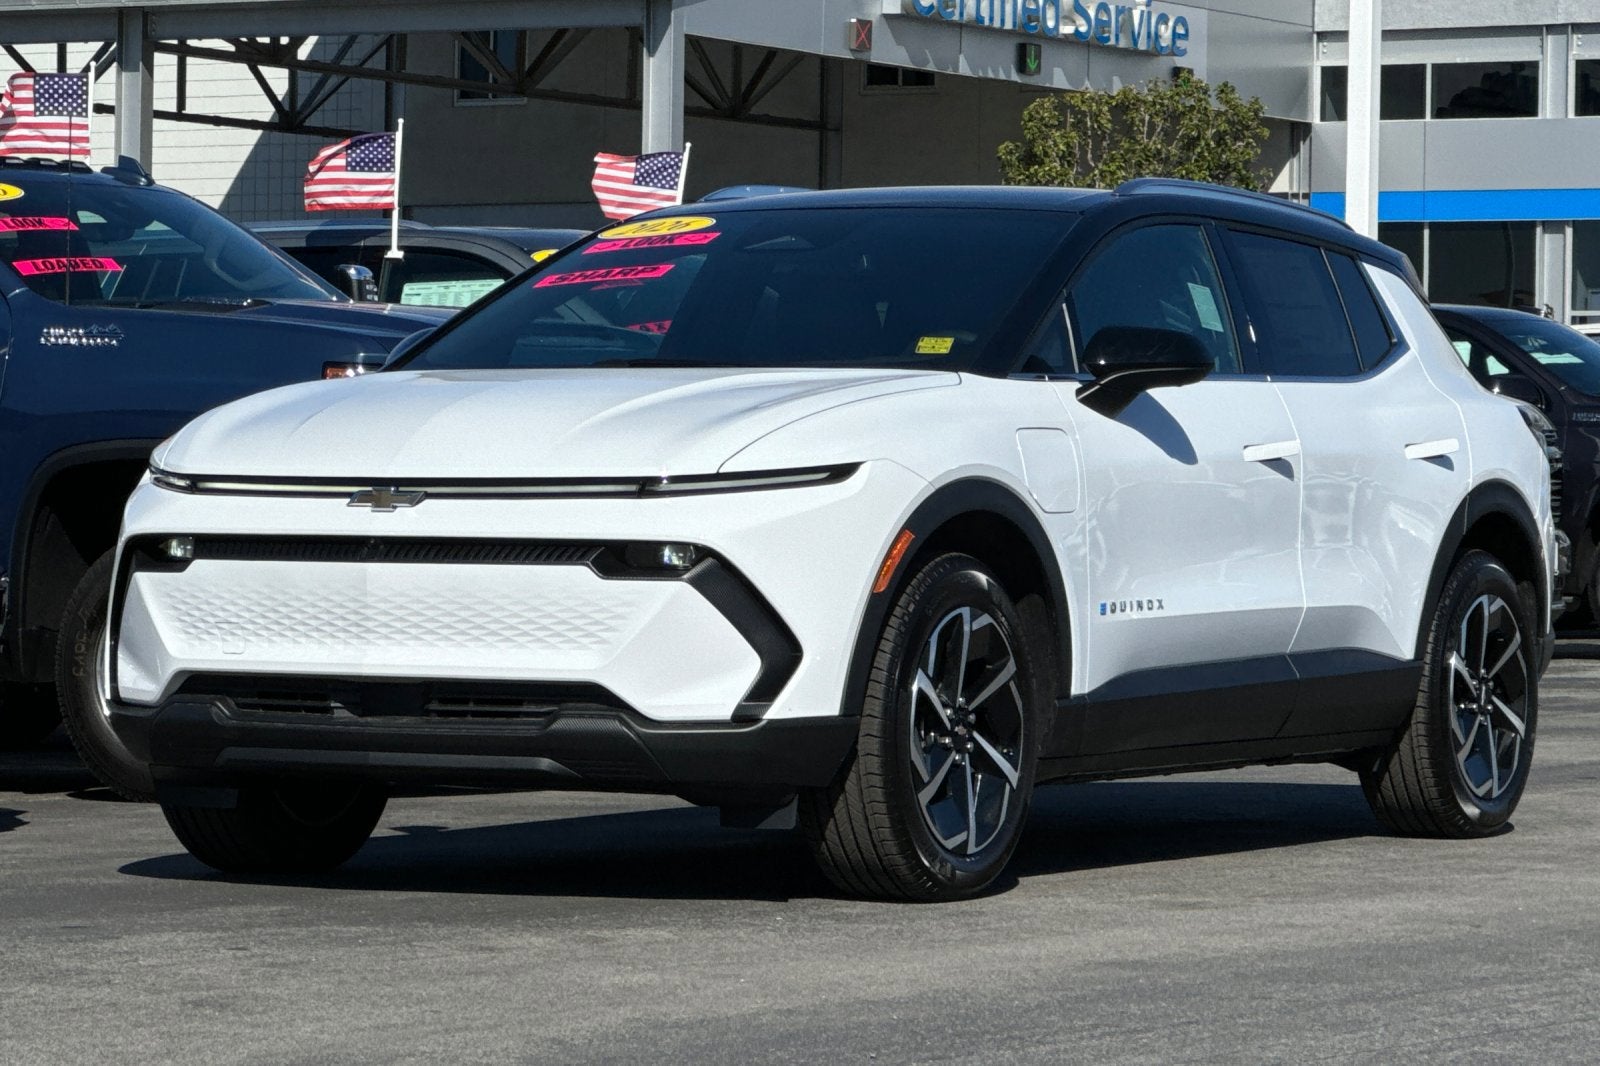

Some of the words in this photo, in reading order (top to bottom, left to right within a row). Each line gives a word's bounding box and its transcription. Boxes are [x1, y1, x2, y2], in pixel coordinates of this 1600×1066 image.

[1073, 0, 1190, 57] Service
[5, 217, 46, 229] LOOK
[620, 236, 677, 248] LOOK
[30, 258, 105, 272] LOADED
[549, 265, 661, 285] SHARP
[1100, 599, 1164, 615] EQUINOX
